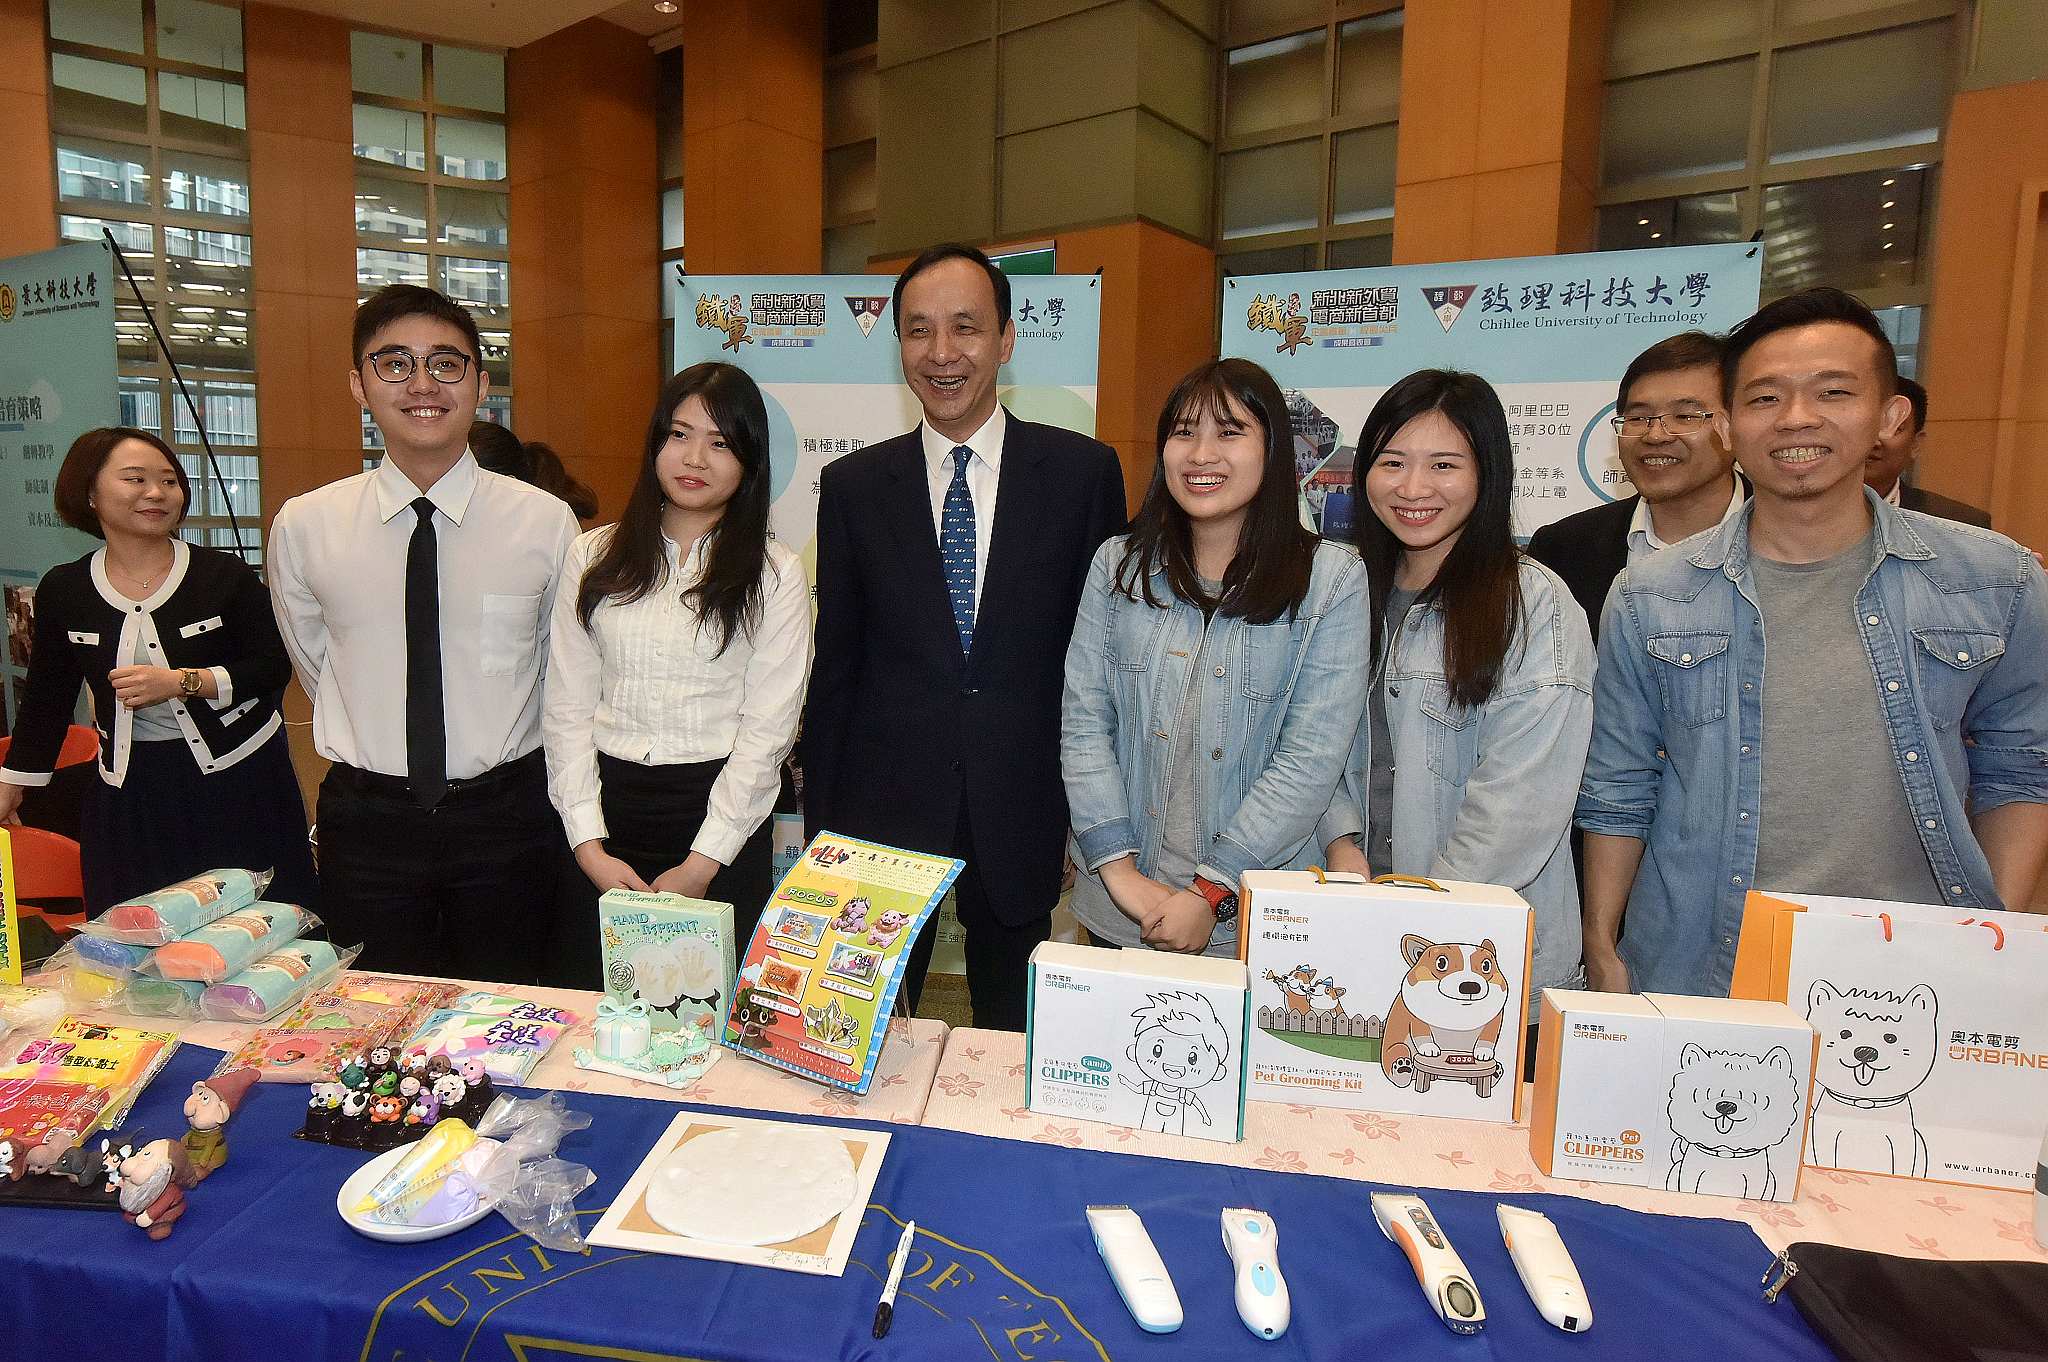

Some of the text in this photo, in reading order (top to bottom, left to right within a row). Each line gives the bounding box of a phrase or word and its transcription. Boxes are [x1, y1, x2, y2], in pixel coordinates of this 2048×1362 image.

[22, 271, 98, 307] 景文科技大學
[1480, 272, 1711, 314] 致理科技大學
[1018, 297, 1066, 327] 大學
[1479, 311, 1708, 330] Chihlee University of Technology
[1016, 326, 1065, 340] chnology
[1508, 403, 1570, 417] 阿里巴巴
[1508, 423, 1572, 436] 培育30位
[1513, 466, 1565, 480] 金等系
[1263, 914, 1309, 924] URBANER
[1045, 980, 1091, 992] URBANER
[1573, 1030, 1628, 1041] URBANER
[1951, 1030, 2020, 1049] 奧本電剪
[1082, 1058, 1110, 1071] Family
[1041, 1066, 1110, 1086] CLIPPERS
[1255, 1070, 1275, 1082] Pet
[1279, 1073, 1341, 1090] Grooming
[1344, 1079, 1362, 1090] Kit
[1622, 1133, 1640, 1142] Pet
[1564, 1141, 1644, 1160] CLIPPERS
